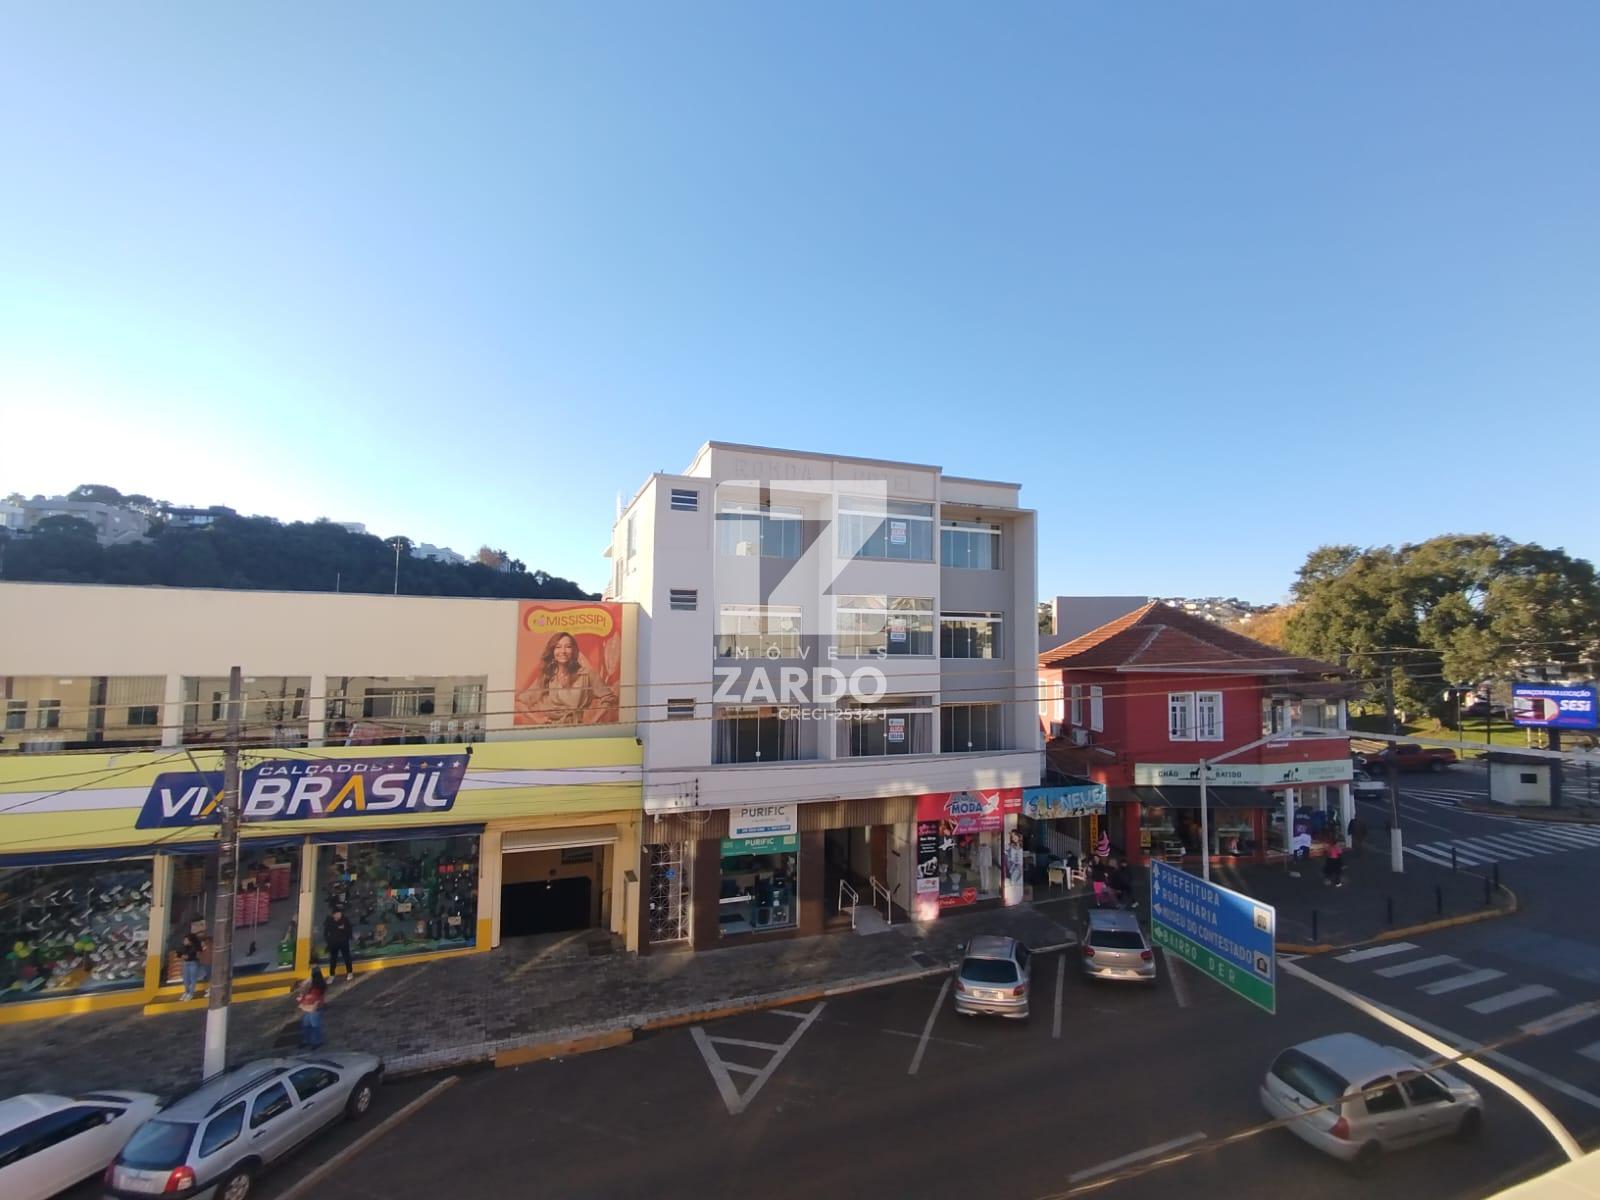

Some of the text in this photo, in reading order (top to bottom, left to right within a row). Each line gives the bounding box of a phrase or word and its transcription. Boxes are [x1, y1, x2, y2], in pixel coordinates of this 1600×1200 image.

[546, 613, 606, 627] MISSISSIPI
[258, 762, 383, 777] CALÇADOS
[243, 771, 448, 816] BRASIL
[741, 806, 785, 818] PURIFIC
[951, 802, 983, 814] MODA
[745, 838, 775, 846] PURIFIC
[1162, 870, 1220, 907] PREFEITURA
[1162, 888, 1217, 927] RODOVIÁRIA
[1163, 930, 1197, 961] BAIRRO
[1187, 919, 1198, 935] DO
[1198, 926, 1253, 965] CONTESTADO
